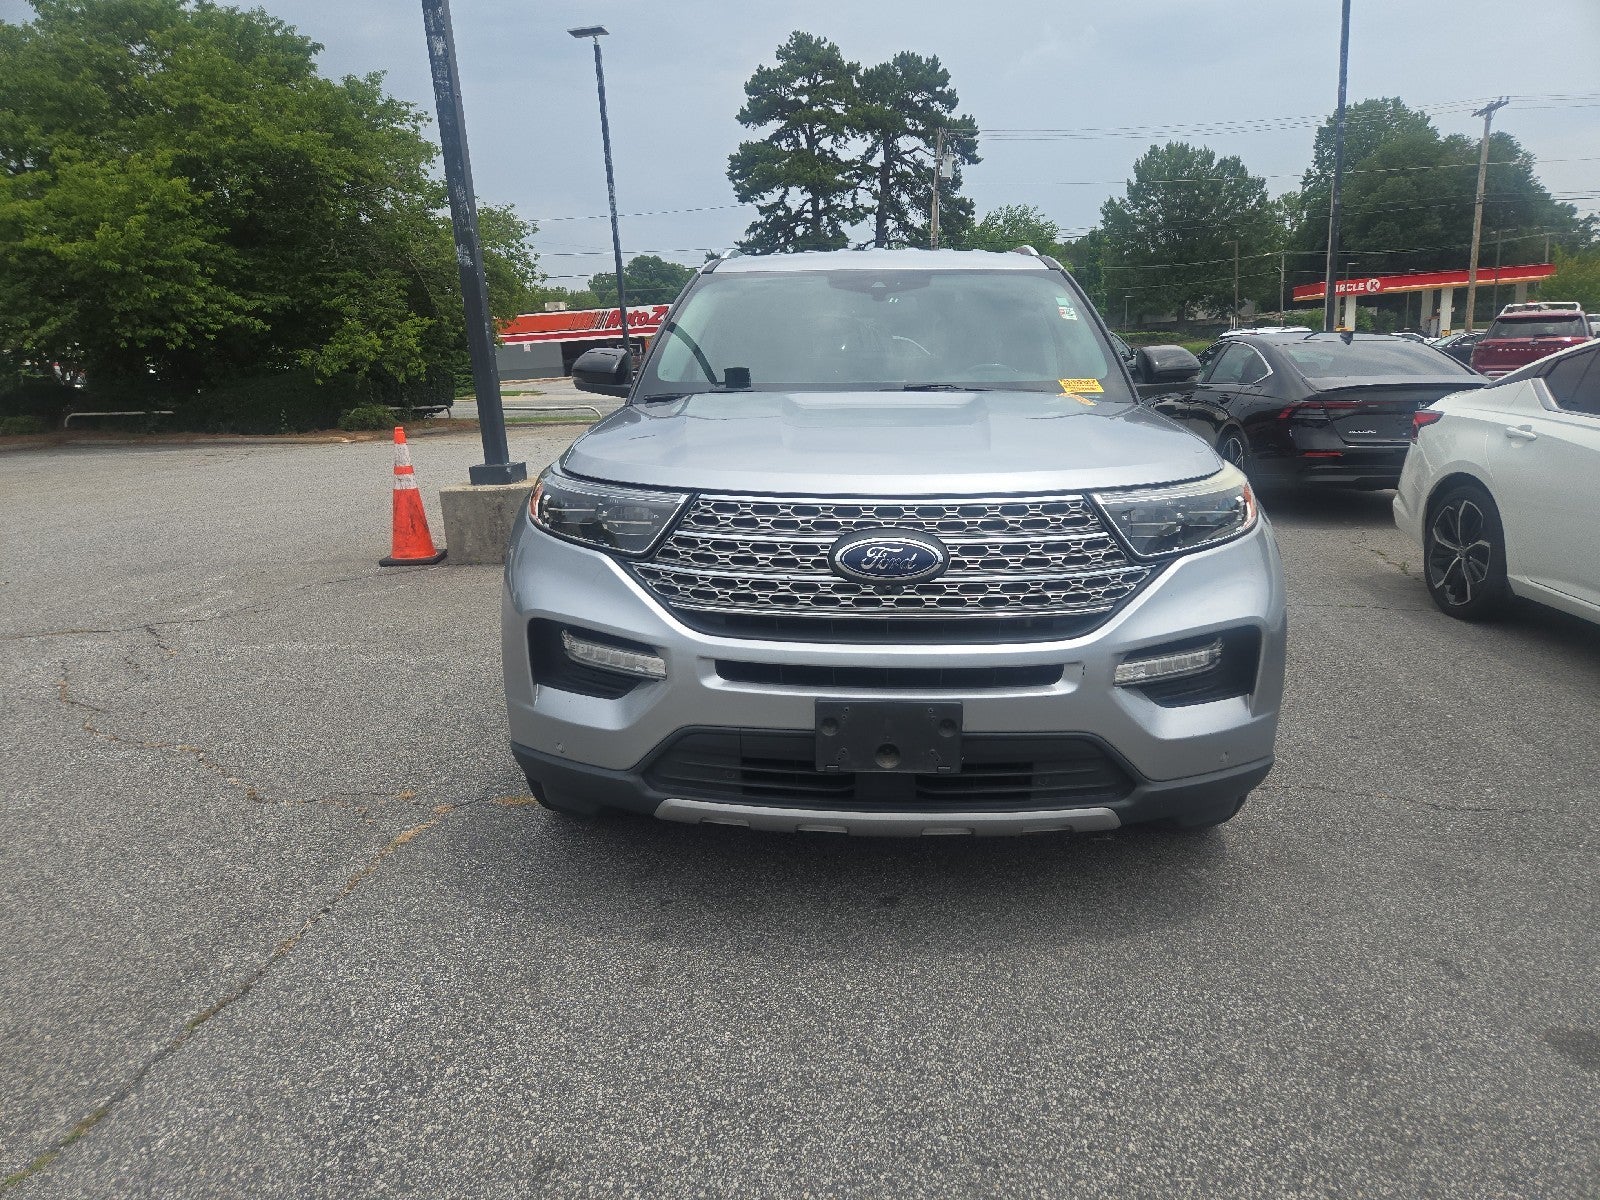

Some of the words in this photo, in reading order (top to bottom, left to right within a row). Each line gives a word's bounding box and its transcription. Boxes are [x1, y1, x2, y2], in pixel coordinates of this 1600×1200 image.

[1335, 282, 1365, 293] IRCLE
[1369, 280, 1379, 291] K
[605, 306, 670, 328] AutoZ
[860, 546, 918, 570] Ford
